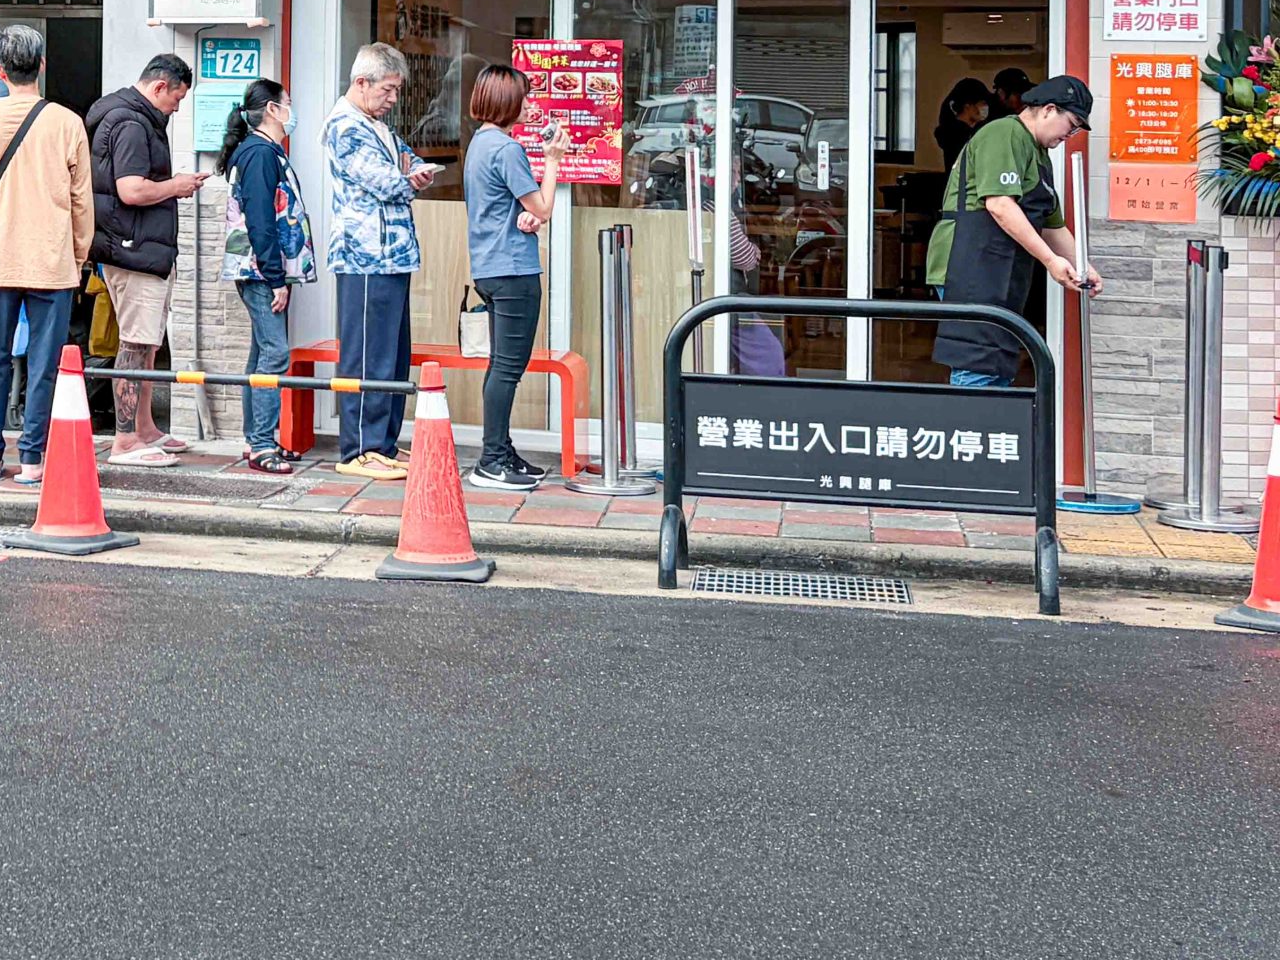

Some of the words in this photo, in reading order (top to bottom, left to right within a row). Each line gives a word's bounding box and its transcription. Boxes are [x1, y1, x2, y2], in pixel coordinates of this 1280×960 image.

[1112, 11, 1199, 32] 請勿停車
[219, 52, 256, 74] 124
[1116, 62, 1194, 79] 光興腿庫
[696, 415, 1020, 463] 營業出入口請勿停車
[819, 474, 893, 492] 光興腿庫
